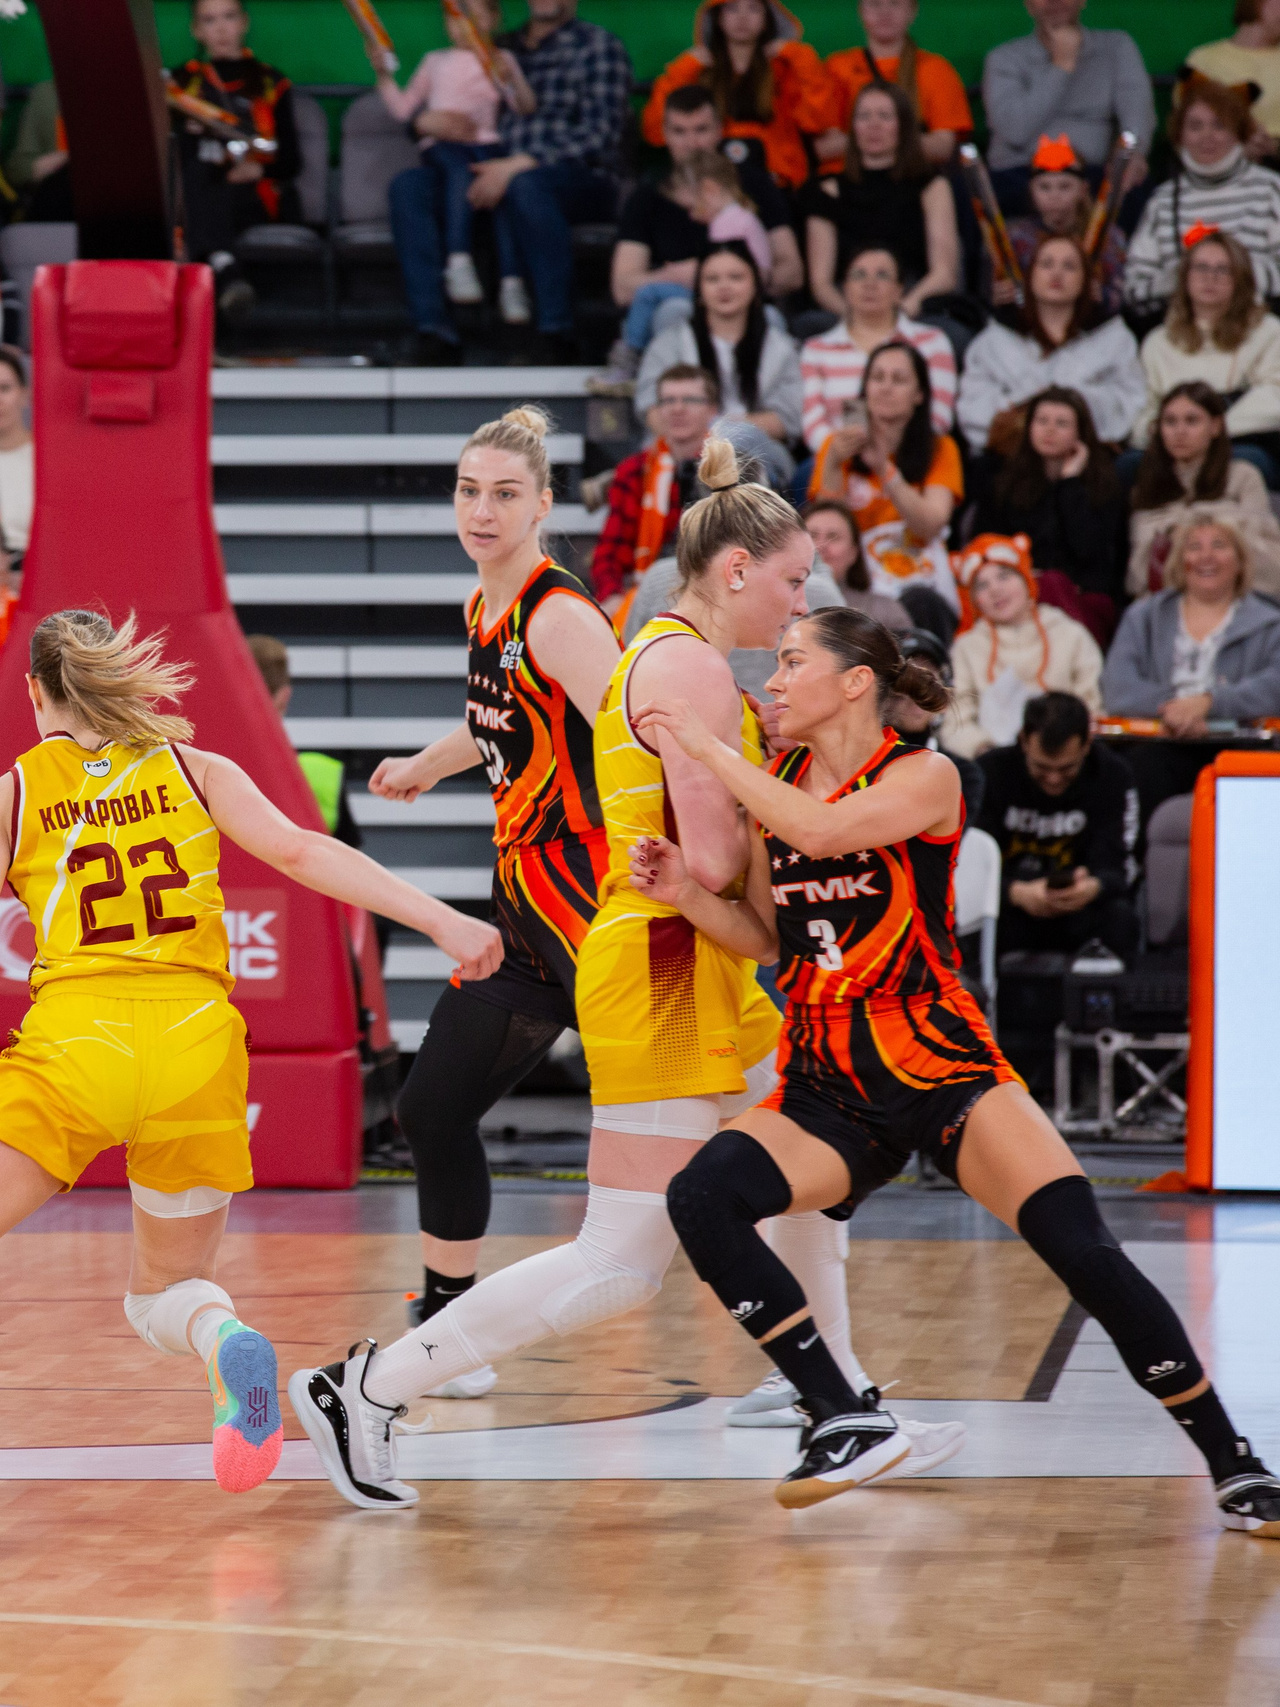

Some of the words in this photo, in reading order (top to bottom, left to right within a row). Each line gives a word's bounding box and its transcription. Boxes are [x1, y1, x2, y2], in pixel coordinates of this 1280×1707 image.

[465, 700, 517, 732] ГМК
[38, 788, 156, 834] КОМАРОВА
[67, 837, 197, 946] 22
[771, 869, 884, 907] ГМК
[807, 919, 844, 971] 3
